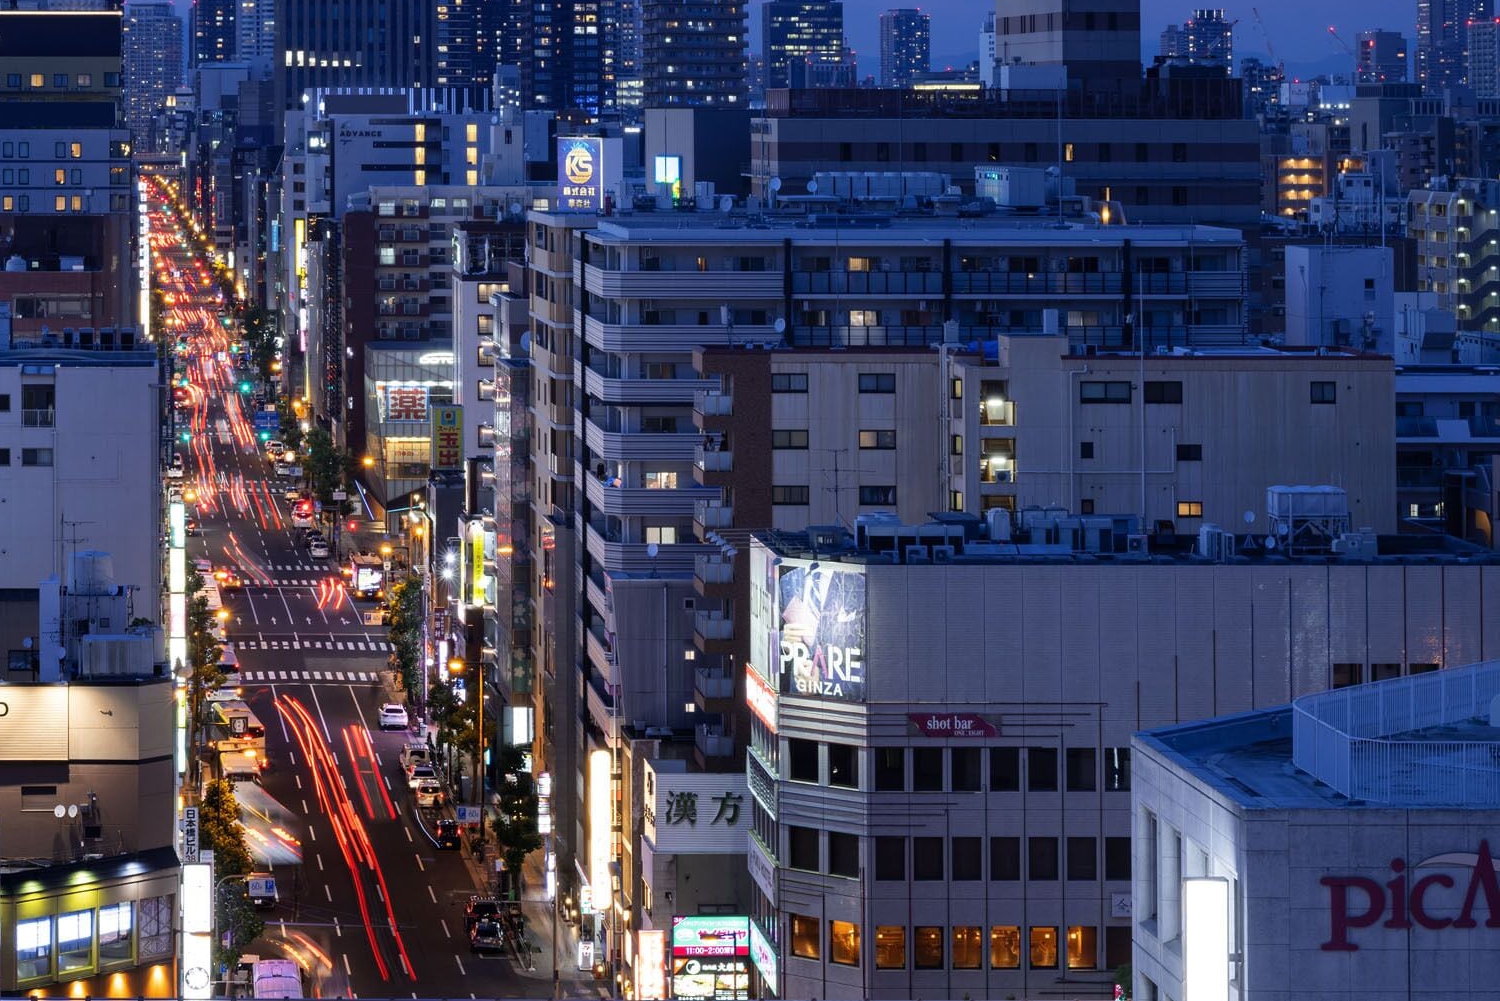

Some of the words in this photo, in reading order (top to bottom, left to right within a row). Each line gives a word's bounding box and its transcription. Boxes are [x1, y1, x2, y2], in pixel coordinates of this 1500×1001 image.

[567, 155, 593, 177] KS
[389, 388, 426, 420] 薬
[438, 433, 459, 466] 玉出
[781, 641, 861, 683] PRARE
[797, 680, 843, 697] GINZA
[927, 715, 951, 729] shot
[954, 715, 973, 729] bar
[665, 791, 744, 827] 漢方
[185, 809, 196, 855] 日本橋ビル
